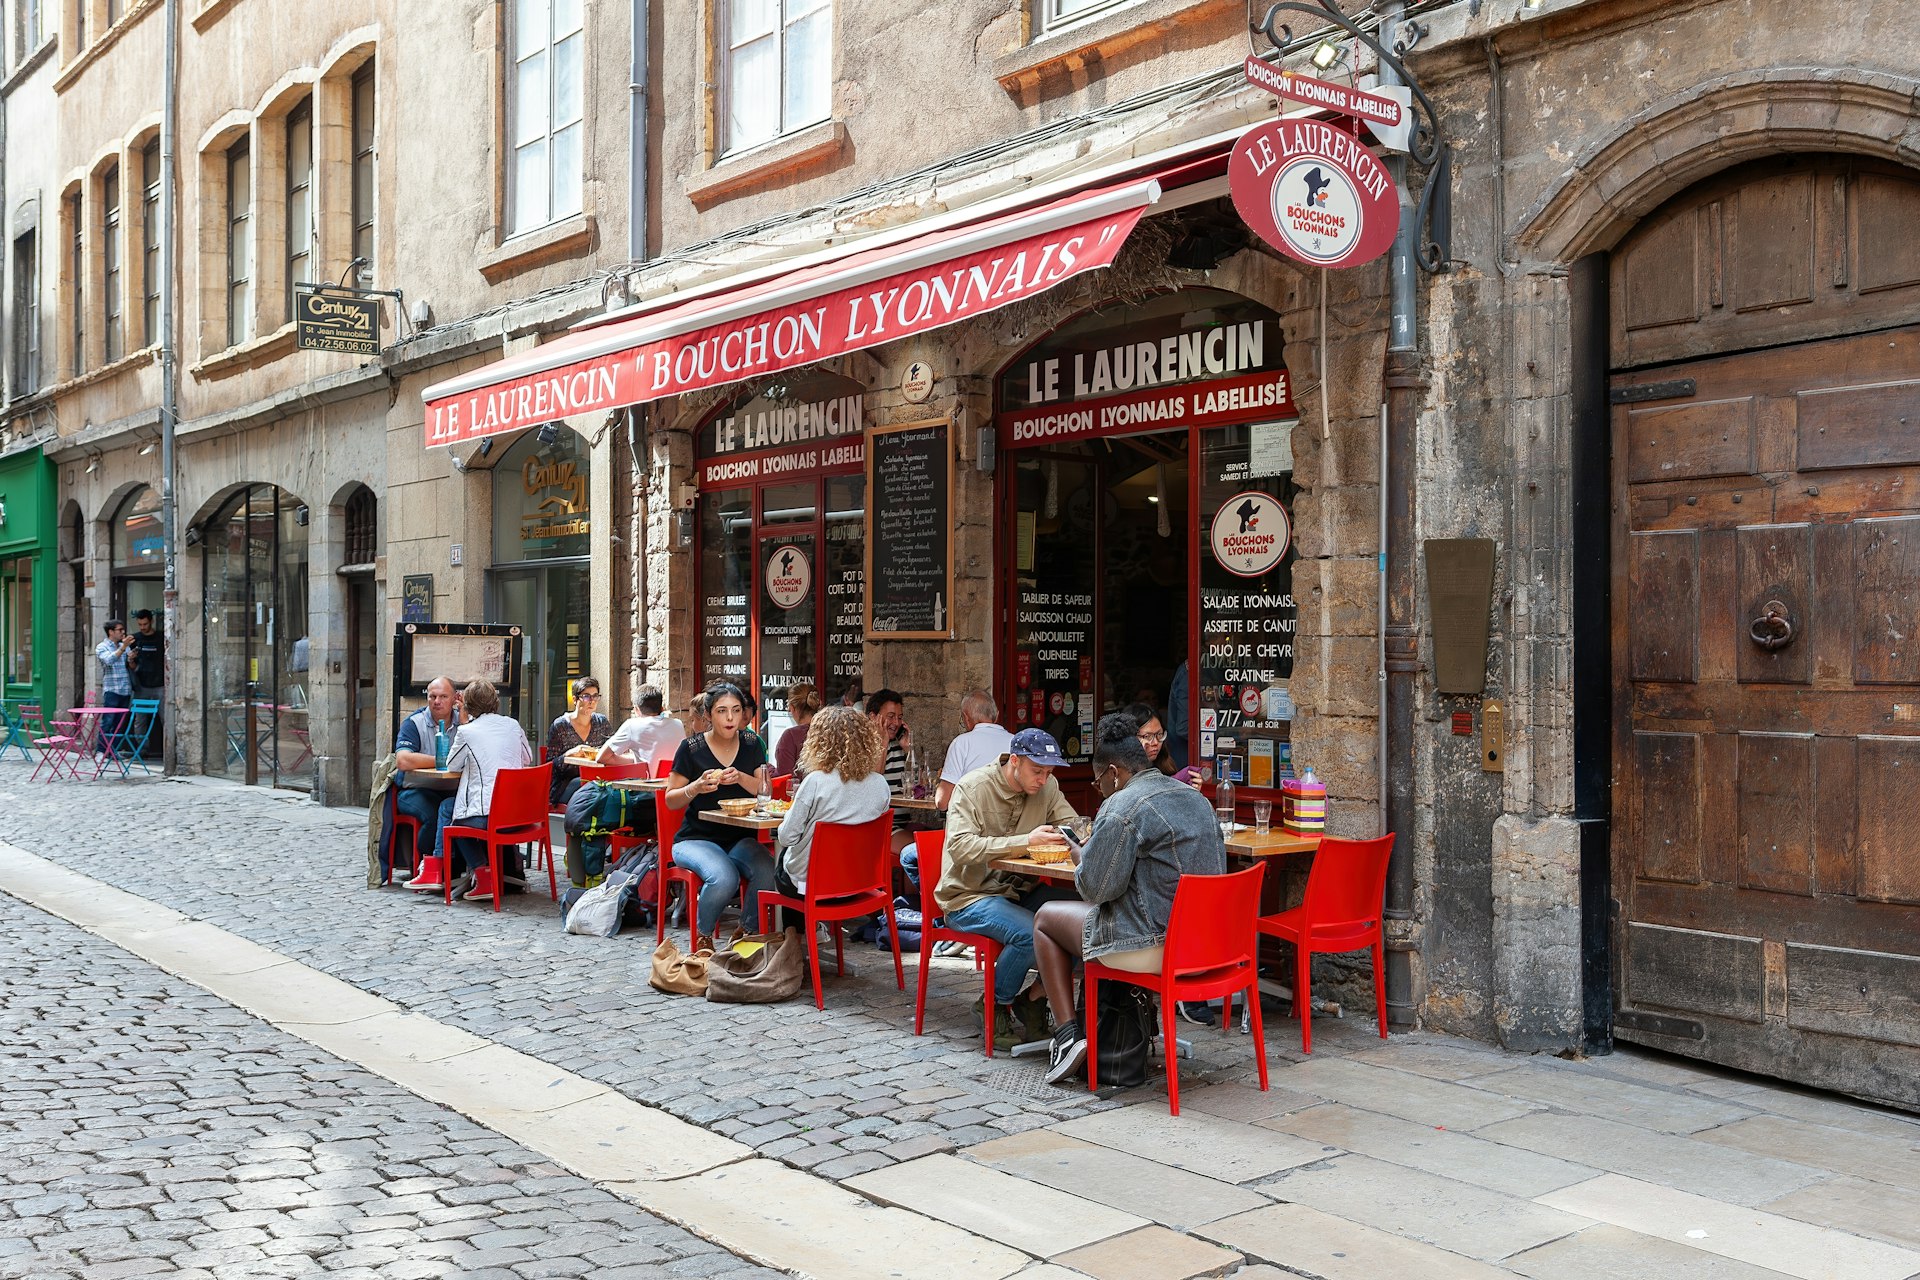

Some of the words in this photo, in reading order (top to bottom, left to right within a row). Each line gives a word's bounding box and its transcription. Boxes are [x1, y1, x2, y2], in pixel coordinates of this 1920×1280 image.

[1248, 61, 1291, 93] BOUCHON
[1295, 80, 1346, 107] LYONNAIS
[1350, 95, 1398, 121] LABELLISÉ
[1245, 135, 1277, 176] LE
[1277, 123, 1389, 202] LAURENCIN
[1287, 205, 1345, 229] BOUCHONS
[1293, 219, 1338, 238] LYONNAIS
[308, 296, 360, 318] Century
[354, 313, 369, 330] 21
[317, 328, 334, 336] Jean
[335, 329, 371, 338] Immobilier
[305, 338, 372, 352] 04.72.56.06.02
[1029, 359, 1059, 403] LE
[1074, 320, 1263, 396] LAURENCIN
[432, 407, 459, 440] LE
[470, 363, 620, 432] LAURENCIN
[1014, 410, 1093, 441] BOUCHON
[1100, 397, 1185, 428] LYONNAIS
[1193, 375, 1286, 415] LABELLISÉ
[715, 417, 734, 452] LE
[744, 394, 862, 448] LAURENCIN
[707, 459, 758, 482] BOUCHON
[763, 451, 816, 474] LYONNAIS
[1225, 462, 1248, 471] SERVICE
[522, 455, 577, 495] Century
[1220, 472, 1241, 481] SAMEDI
[1242, 472, 1249, 480] ET
[1250, 469, 1281, 479] DIMANCHE
[1223, 534, 1275, 547] BOUCHONS
[1228, 545, 1268, 556] LYONNAIS
[773, 577, 802, 587] BOUCHONS
[843, 571, 856, 581] POT
[775, 586, 799, 594] LYONNAIS
[828, 583, 844, 594] COTE
[847, 583, 856, 593] DU
[707, 596, 725, 606] CREME
[1022, 593, 1050, 605] TABLIER
[1051, 594, 1062, 605] DE
[1064, 594, 1092, 606] SAPEUR
[1203, 595, 1240, 609] SALADE
[844, 603, 856, 613] POT
[1019, 612, 1063, 624] SAUCISSON
[1065, 612, 1092, 624] CHAUD
[438, 624, 489, 635] MNU
[706, 627, 714, 637] AU
[716, 626, 746, 637] CHOCOLAT
[765, 626, 788, 635] BOUCHON
[1204, 619, 1243, 633] ASSIETTE
[1246, 619, 1259, 633] DE
[829, 634, 842, 644] POT
[844, 634, 852, 644] DE
[1029, 630, 1085, 643] ANDOUILLETTE
[710, 645, 725, 655] TARTE
[726, 645, 742, 655] TATIN
[1038, 649, 1078, 661] QUENELLE
[1209, 644, 1234, 657] DUO
[1238, 644, 1252, 657] DE
[706, 664, 721, 674] TARTE
[723, 664, 746, 674] PRALINE
[784, 658, 791, 671] le
[834, 665, 843, 675] DU
[1045, 668, 1070, 680] TRIPES
[1223, 668, 1275, 682] GRATINEE
[765, 698, 774, 710] 04
[775, 698, 784, 710] 78
[1219, 709, 1242, 727] 7/7
[1242, 720, 1256, 728] MIDI
[1256, 720, 1263, 728] et
[1264, 720, 1279, 729] SOIR
